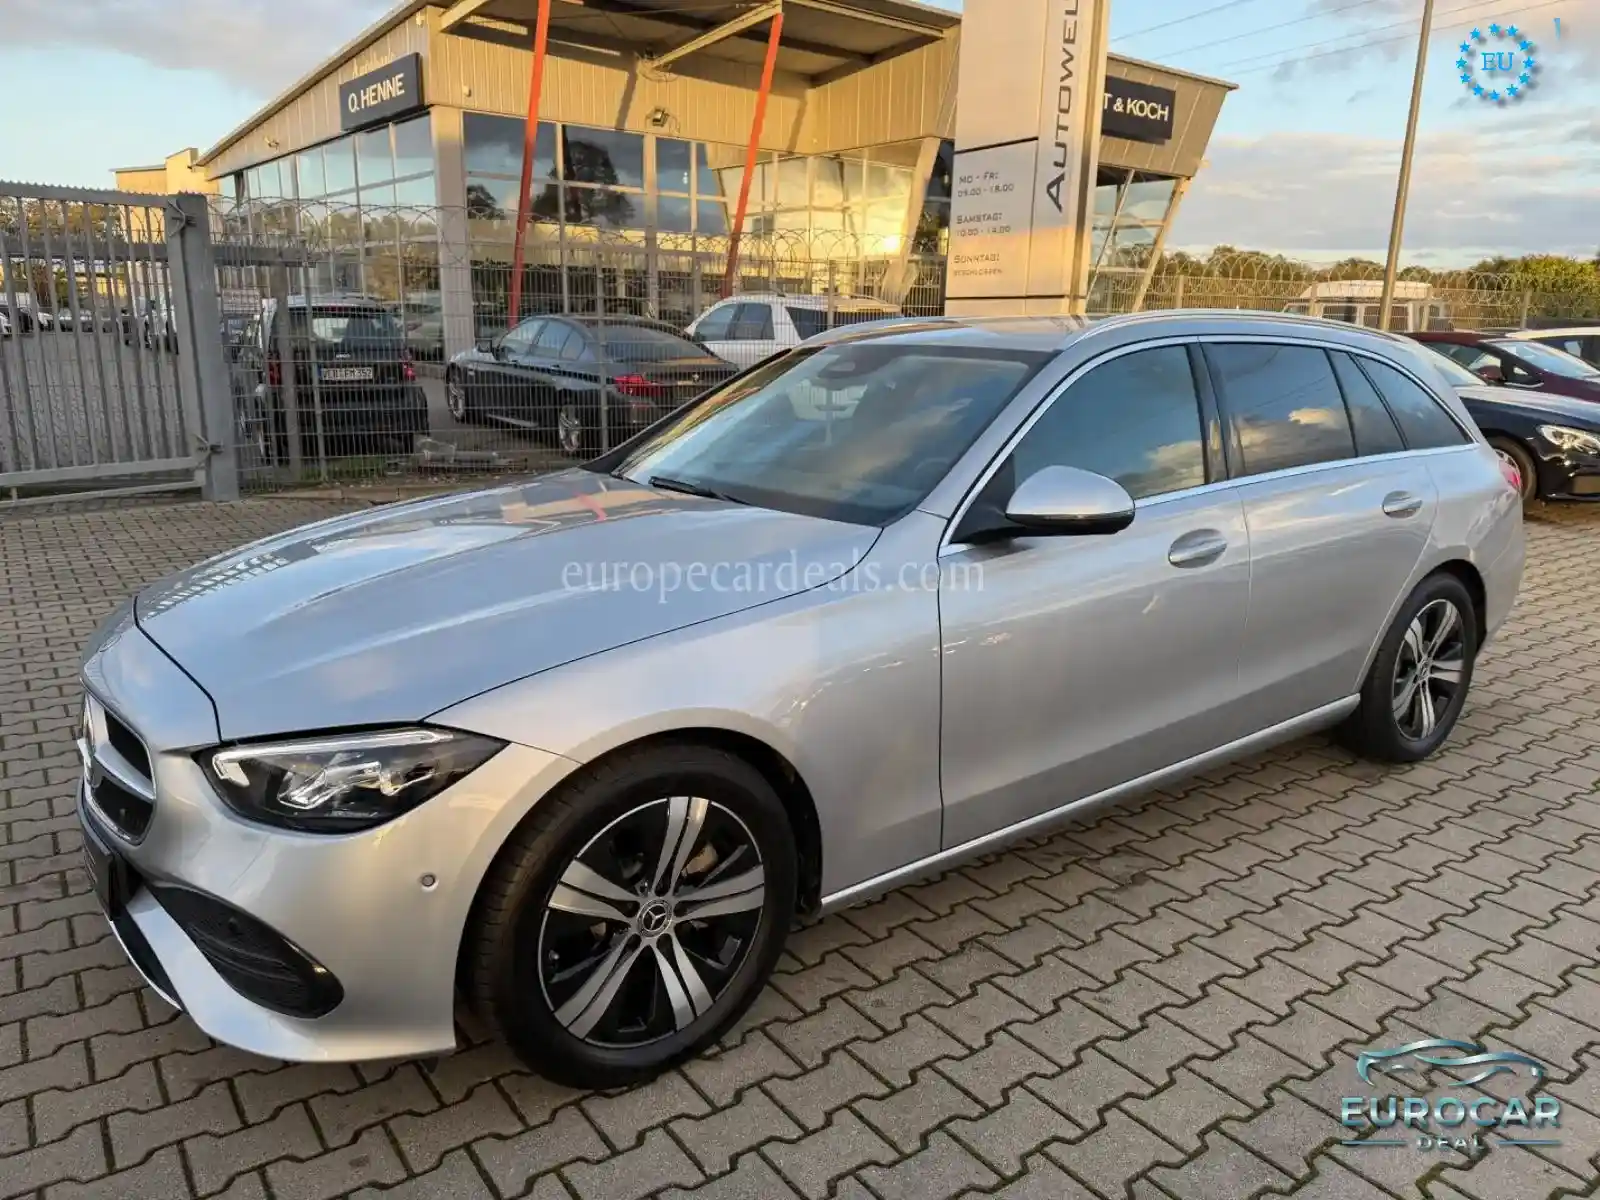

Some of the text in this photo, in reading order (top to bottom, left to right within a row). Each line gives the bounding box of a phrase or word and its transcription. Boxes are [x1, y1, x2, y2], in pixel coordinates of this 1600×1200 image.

[361, 73, 405, 109] HENNE
[1113, 96, 1125, 113] &
[1126, 97, 1170, 122] KOCH
